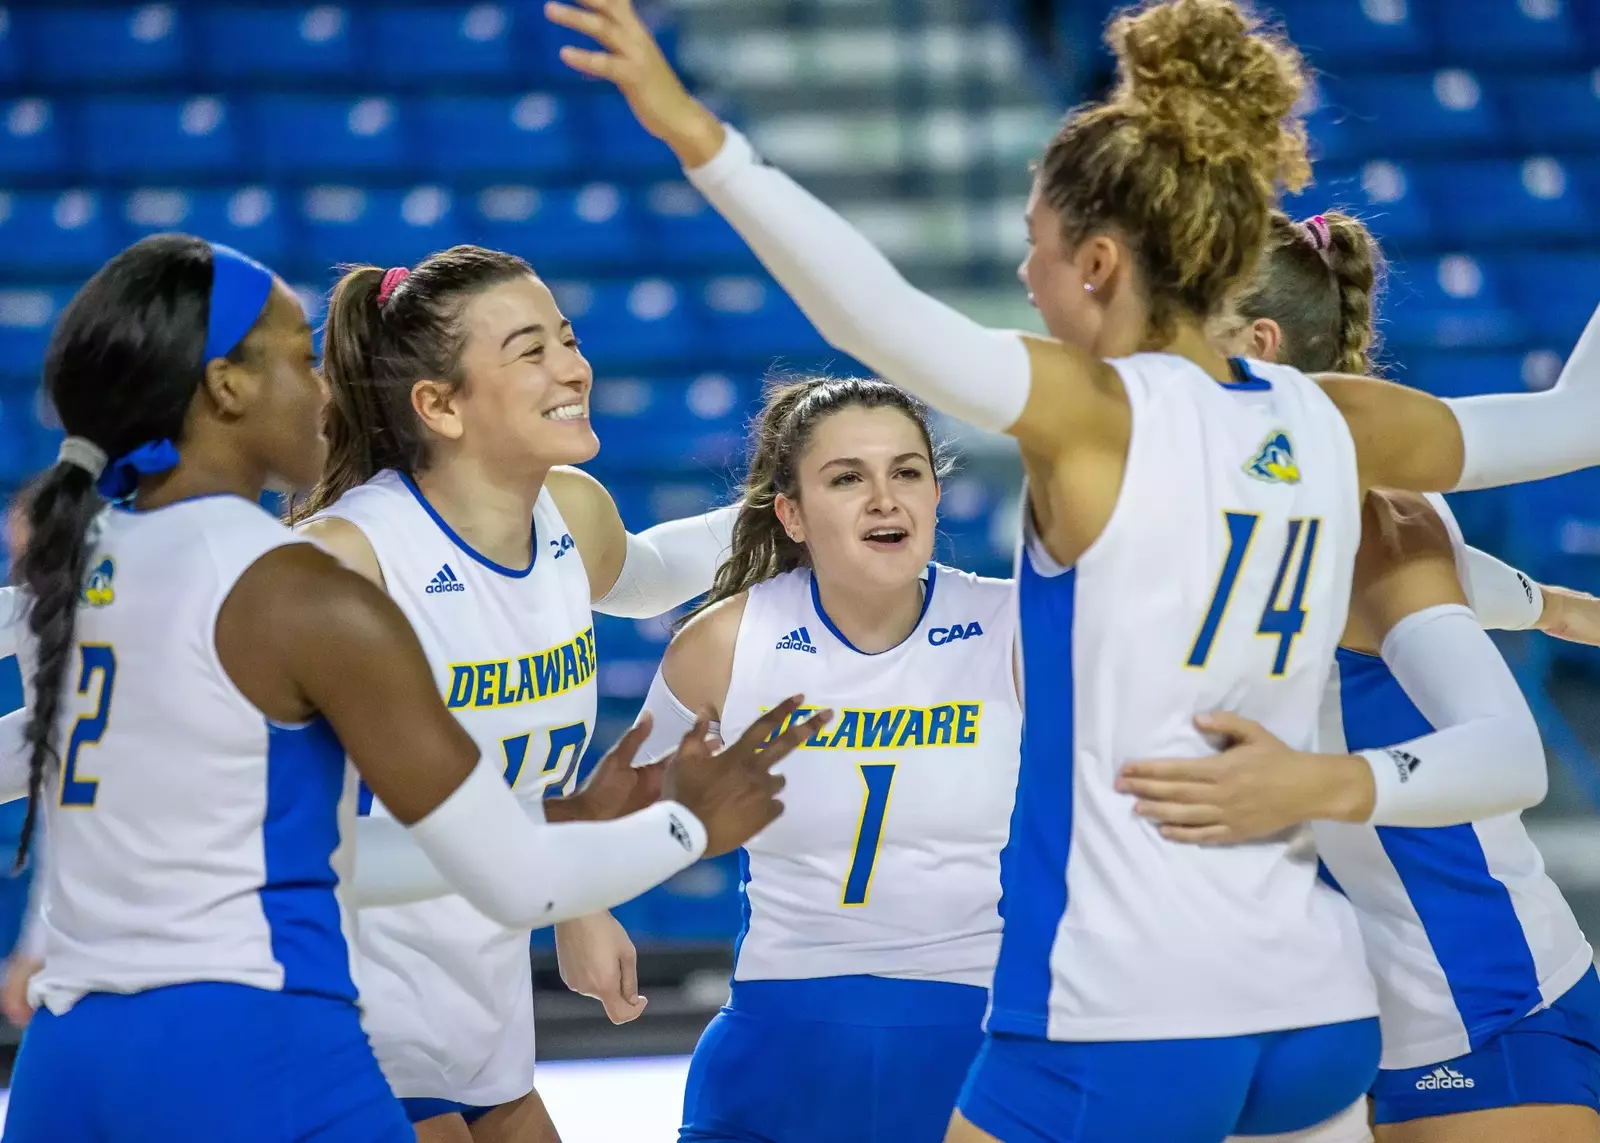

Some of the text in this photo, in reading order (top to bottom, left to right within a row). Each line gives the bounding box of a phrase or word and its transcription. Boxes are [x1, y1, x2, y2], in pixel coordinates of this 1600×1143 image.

[425, 580, 465, 594] adidas
[1182, 509, 1322, 679] 14
[775, 638, 817, 654] adidas
[928, 621, 984, 646] CAA
[444, 624, 597, 712] DELAWARE
[59, 640, 118, 810] 2
[753, 700, 984, 753] LAWARE
[839, 761, 900, 908] 1
[1415, 1076, 1475, 1090] adidas
